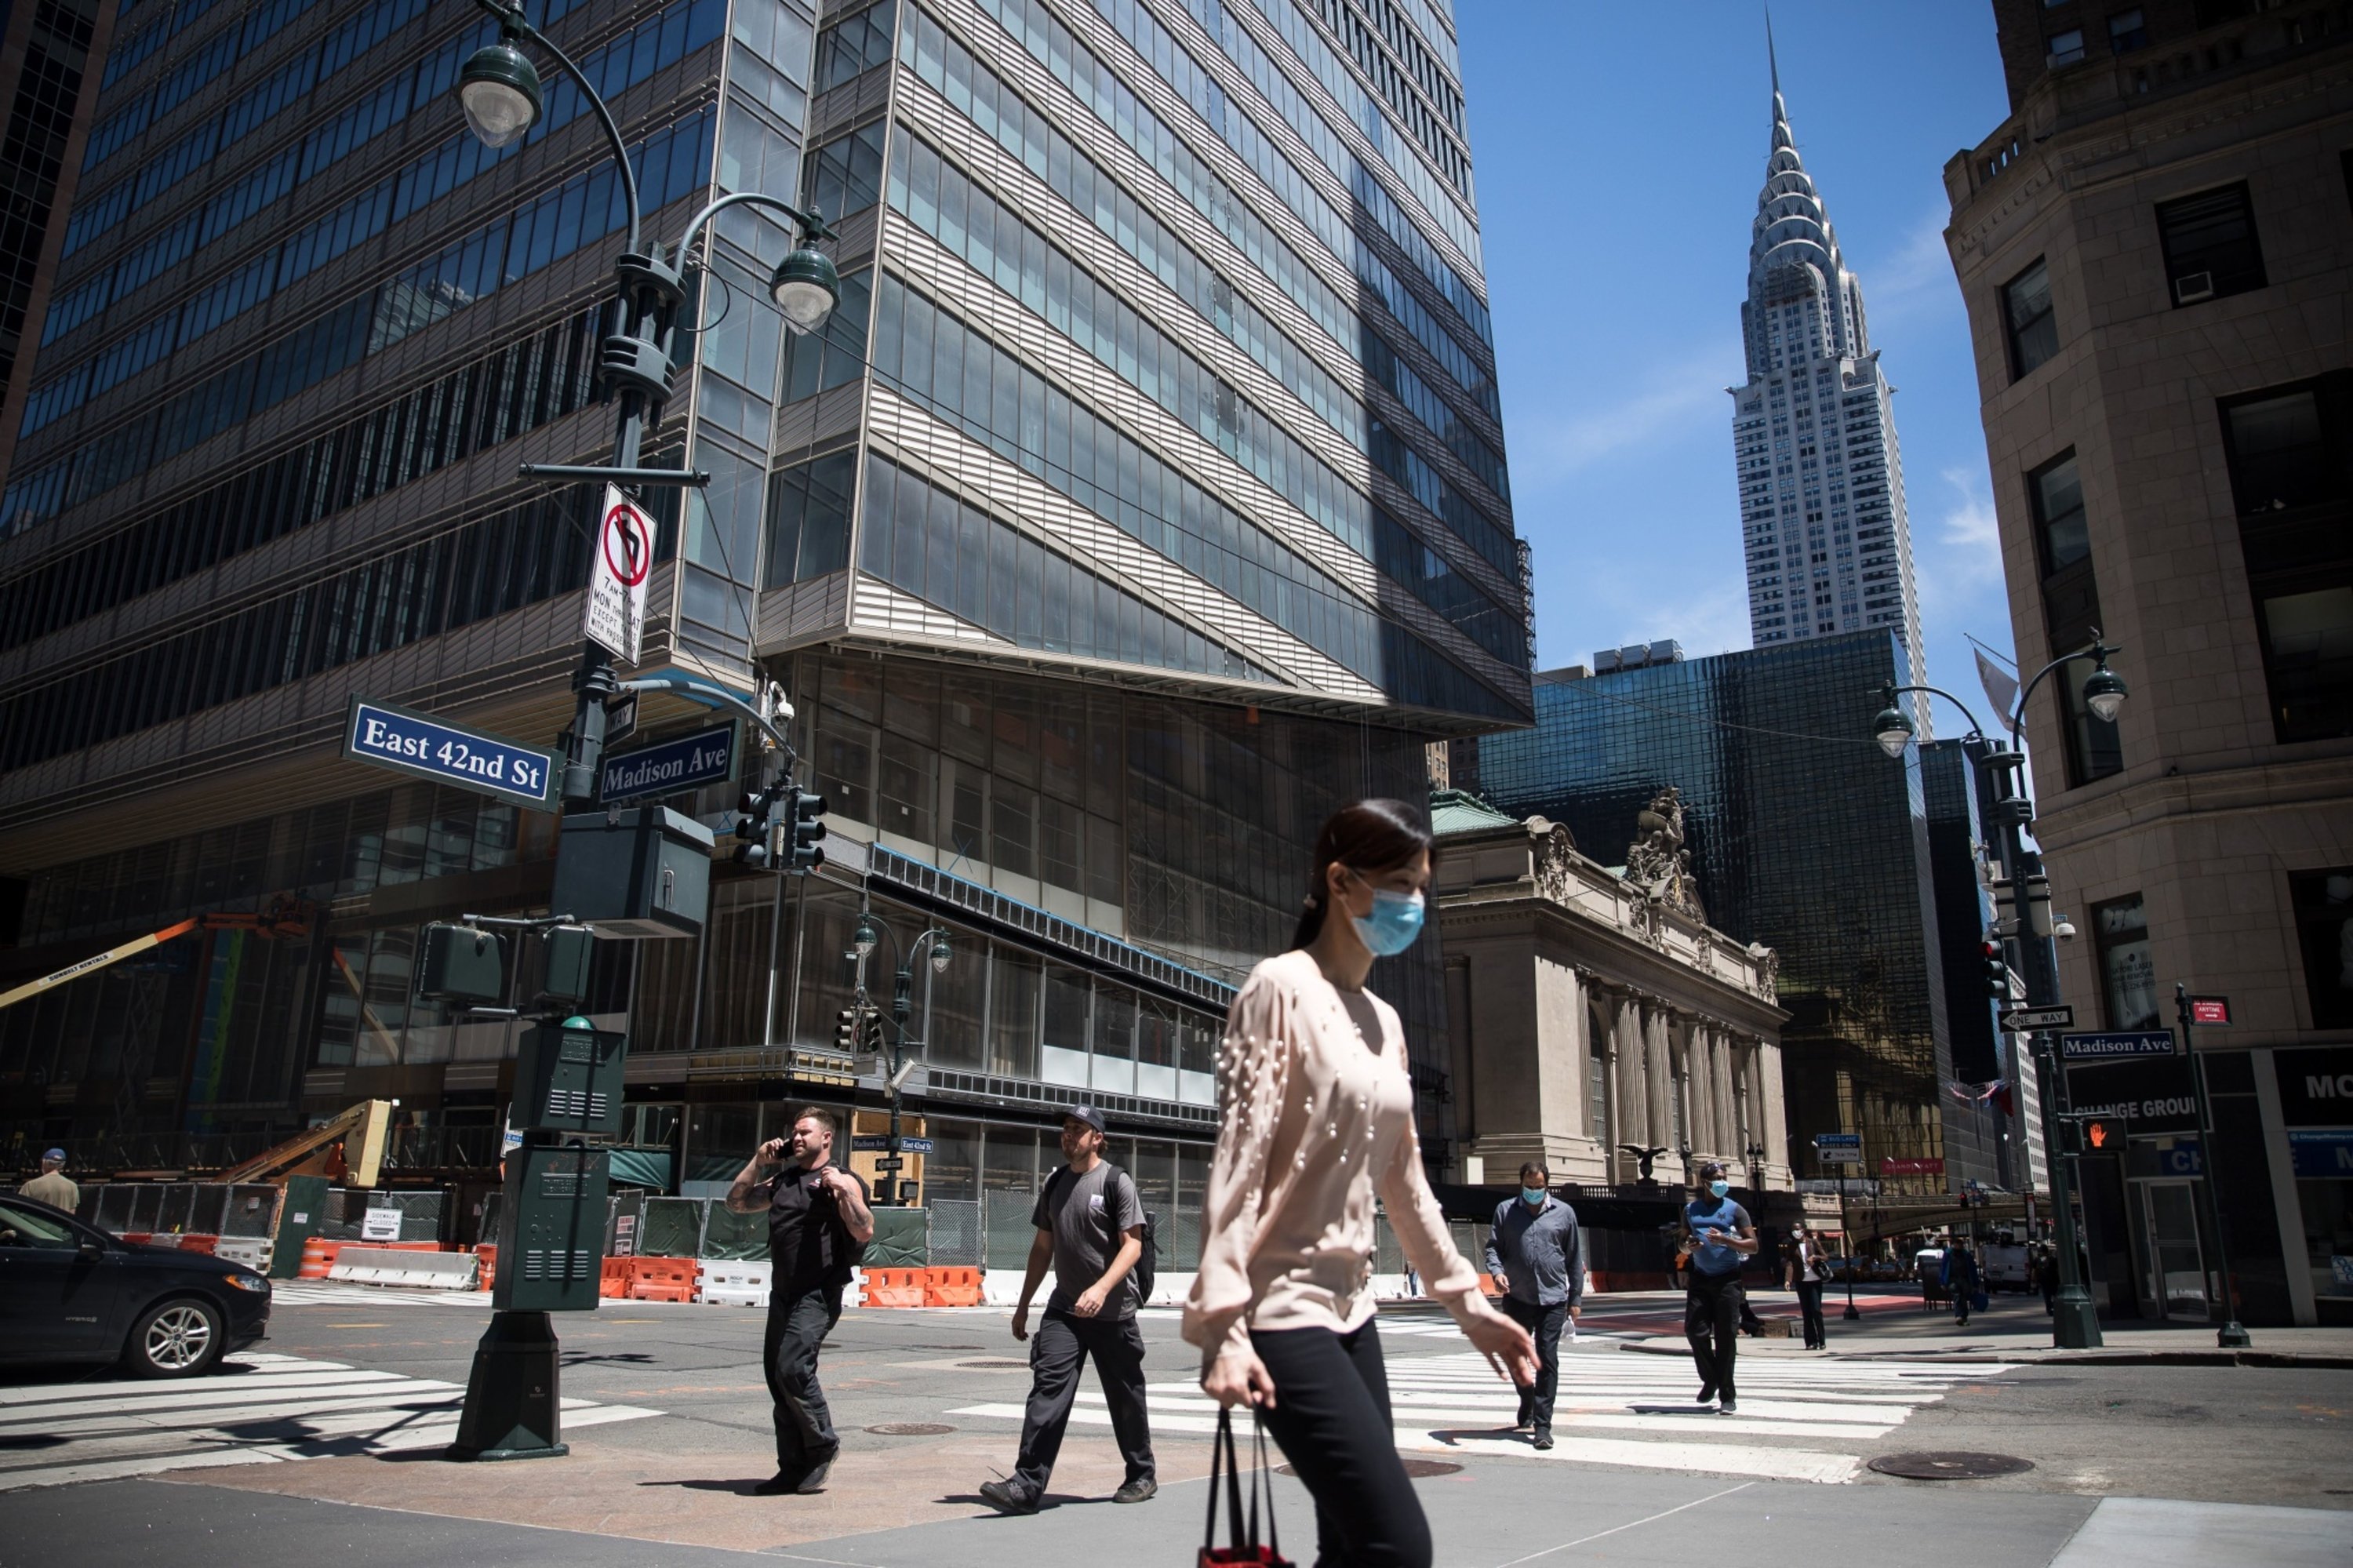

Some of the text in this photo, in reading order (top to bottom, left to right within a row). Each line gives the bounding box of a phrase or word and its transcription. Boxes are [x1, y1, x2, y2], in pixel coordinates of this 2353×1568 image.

[594, 588, 611, 609] MON
[627, 612, 640, 631] SAT
[594, 605, 617, 628] EXCEPT
[591, 617, 604, 632] WITH
[609, 706, 631, 732] WAY
[362, 719, 540, 789] East 42nd St
[603, 747, 726, 793] Madison Ave
[48, 955, 108, 981] SUNBELT RENTALS
[2009, 1013, 2063, 1025] ONE WAY
[2064, 1036, 2171, 1055] Madison Ave
[875, 1139, 886, 1148] Ave
